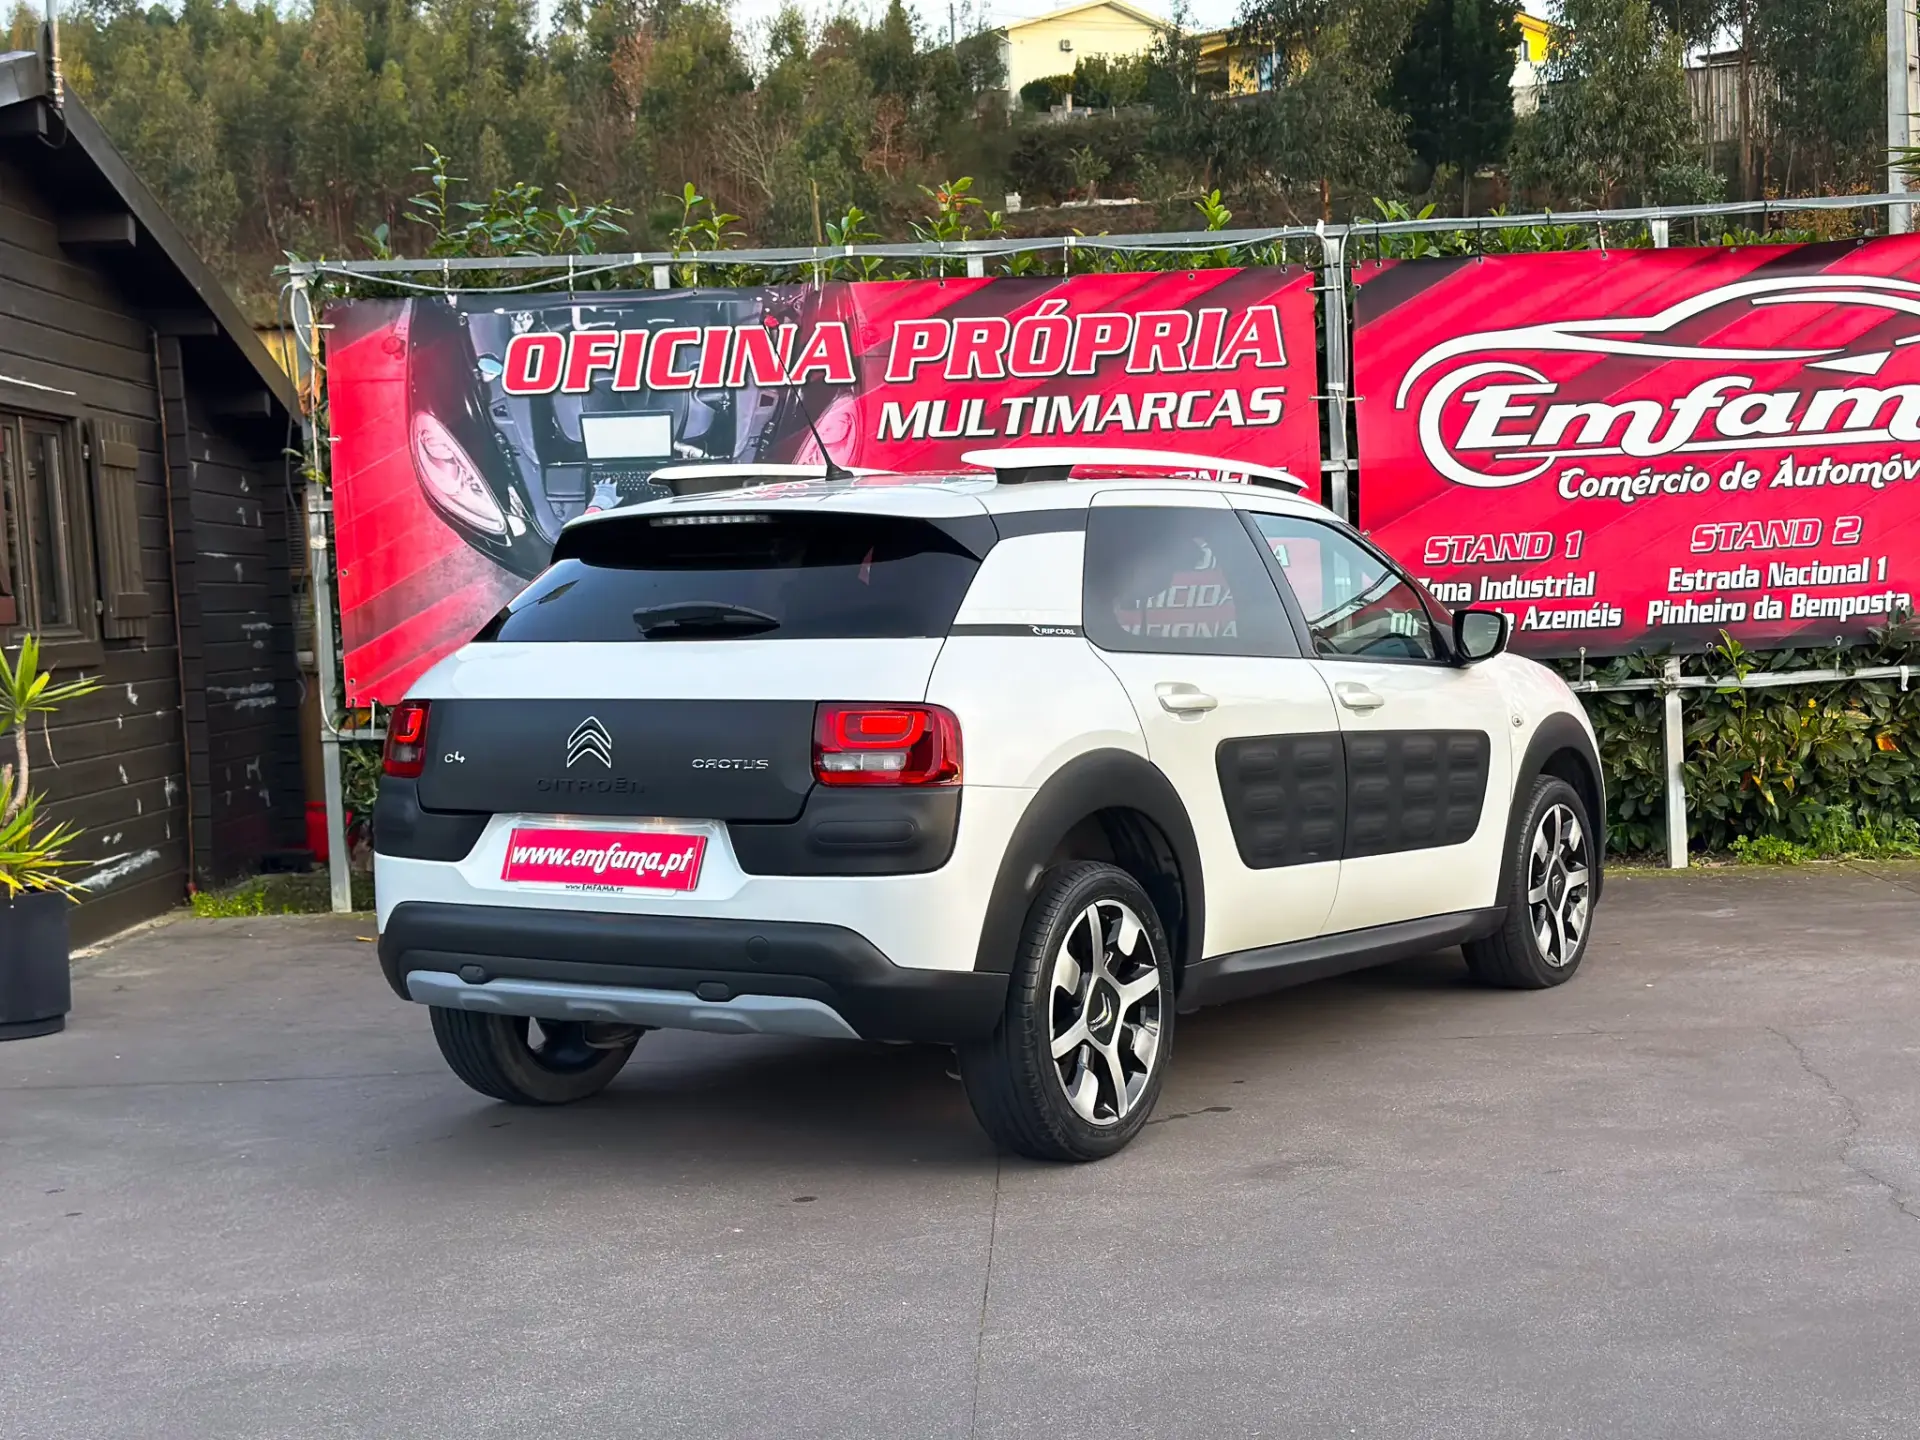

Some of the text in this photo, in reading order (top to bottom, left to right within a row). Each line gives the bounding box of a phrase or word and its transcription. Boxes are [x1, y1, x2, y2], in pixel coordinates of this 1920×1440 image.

[502, 299, 1288, 396] OFICINA PRÓPRIA
[876, 386, 1286, 441] MULTIMARCAS
[1557, 464, 1711, 502] Comércio
[1719, 460, 1758, 490] de
[1423, 529, 1584, 565] STAND 1
[1690, 515, 1863, 553] STAND 2
[1479, 571, 1596, 601] Industrial
[1667, 555, 1888, 592] Estrada Nacional 1
[1520, 602, 1623, 631] Azeméis
[1647, 589, 1911, 626] Pinheiro da Bemposta
[1041, 627, 1056, 636] RIP
[511, 842, 694, 877] www.emfama.pt
